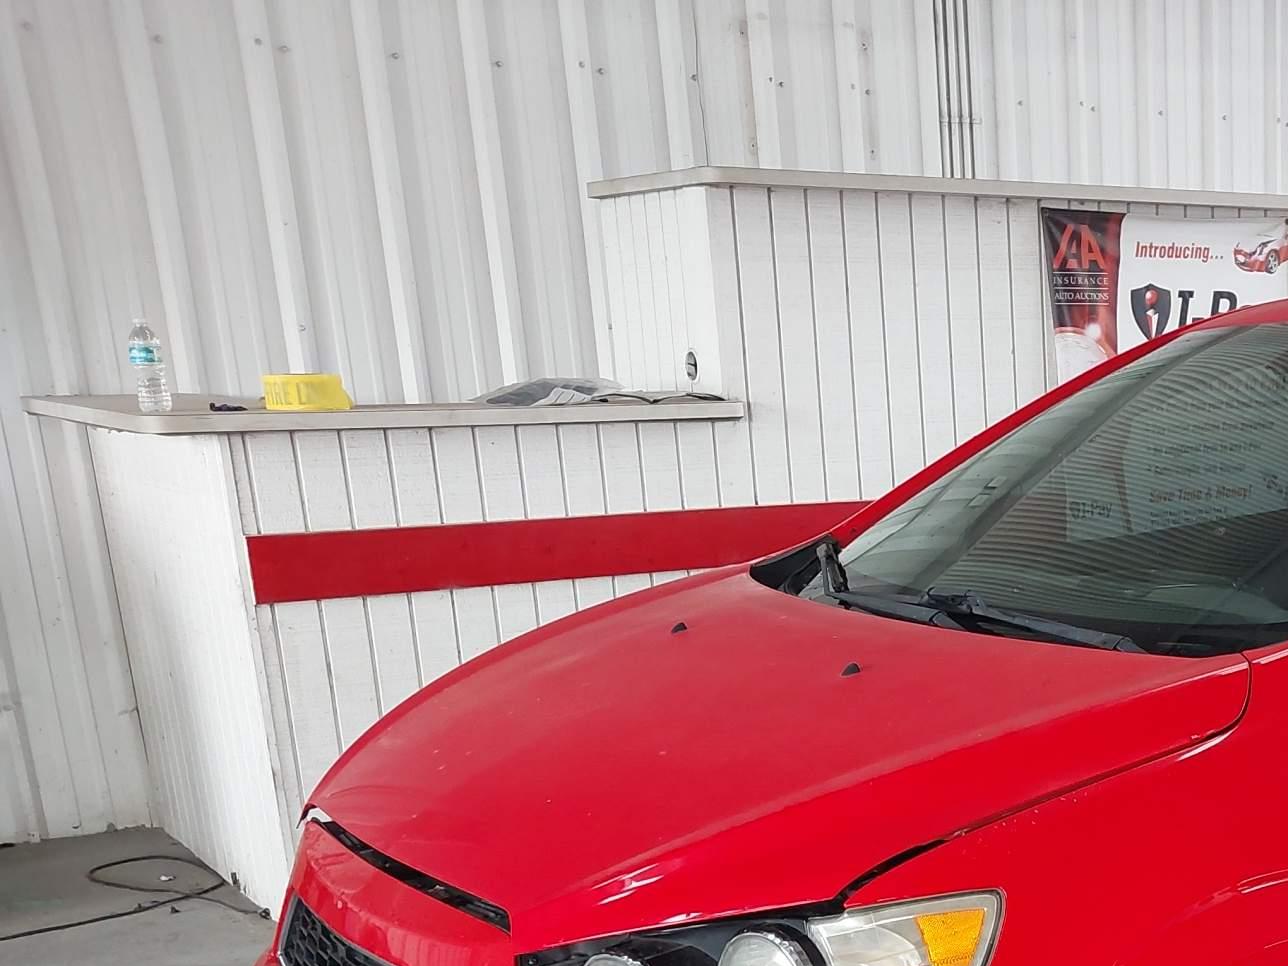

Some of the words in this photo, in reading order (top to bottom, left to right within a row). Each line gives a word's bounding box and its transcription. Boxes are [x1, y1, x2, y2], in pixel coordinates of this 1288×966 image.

[1135, 241, 1224, 263] Introducing...
[1053, 276, 1109, 285] INSURANCE
[1054, 292, 1074, 300] AUTO
[1075, 292, 1109, 300] AUCTIONS
